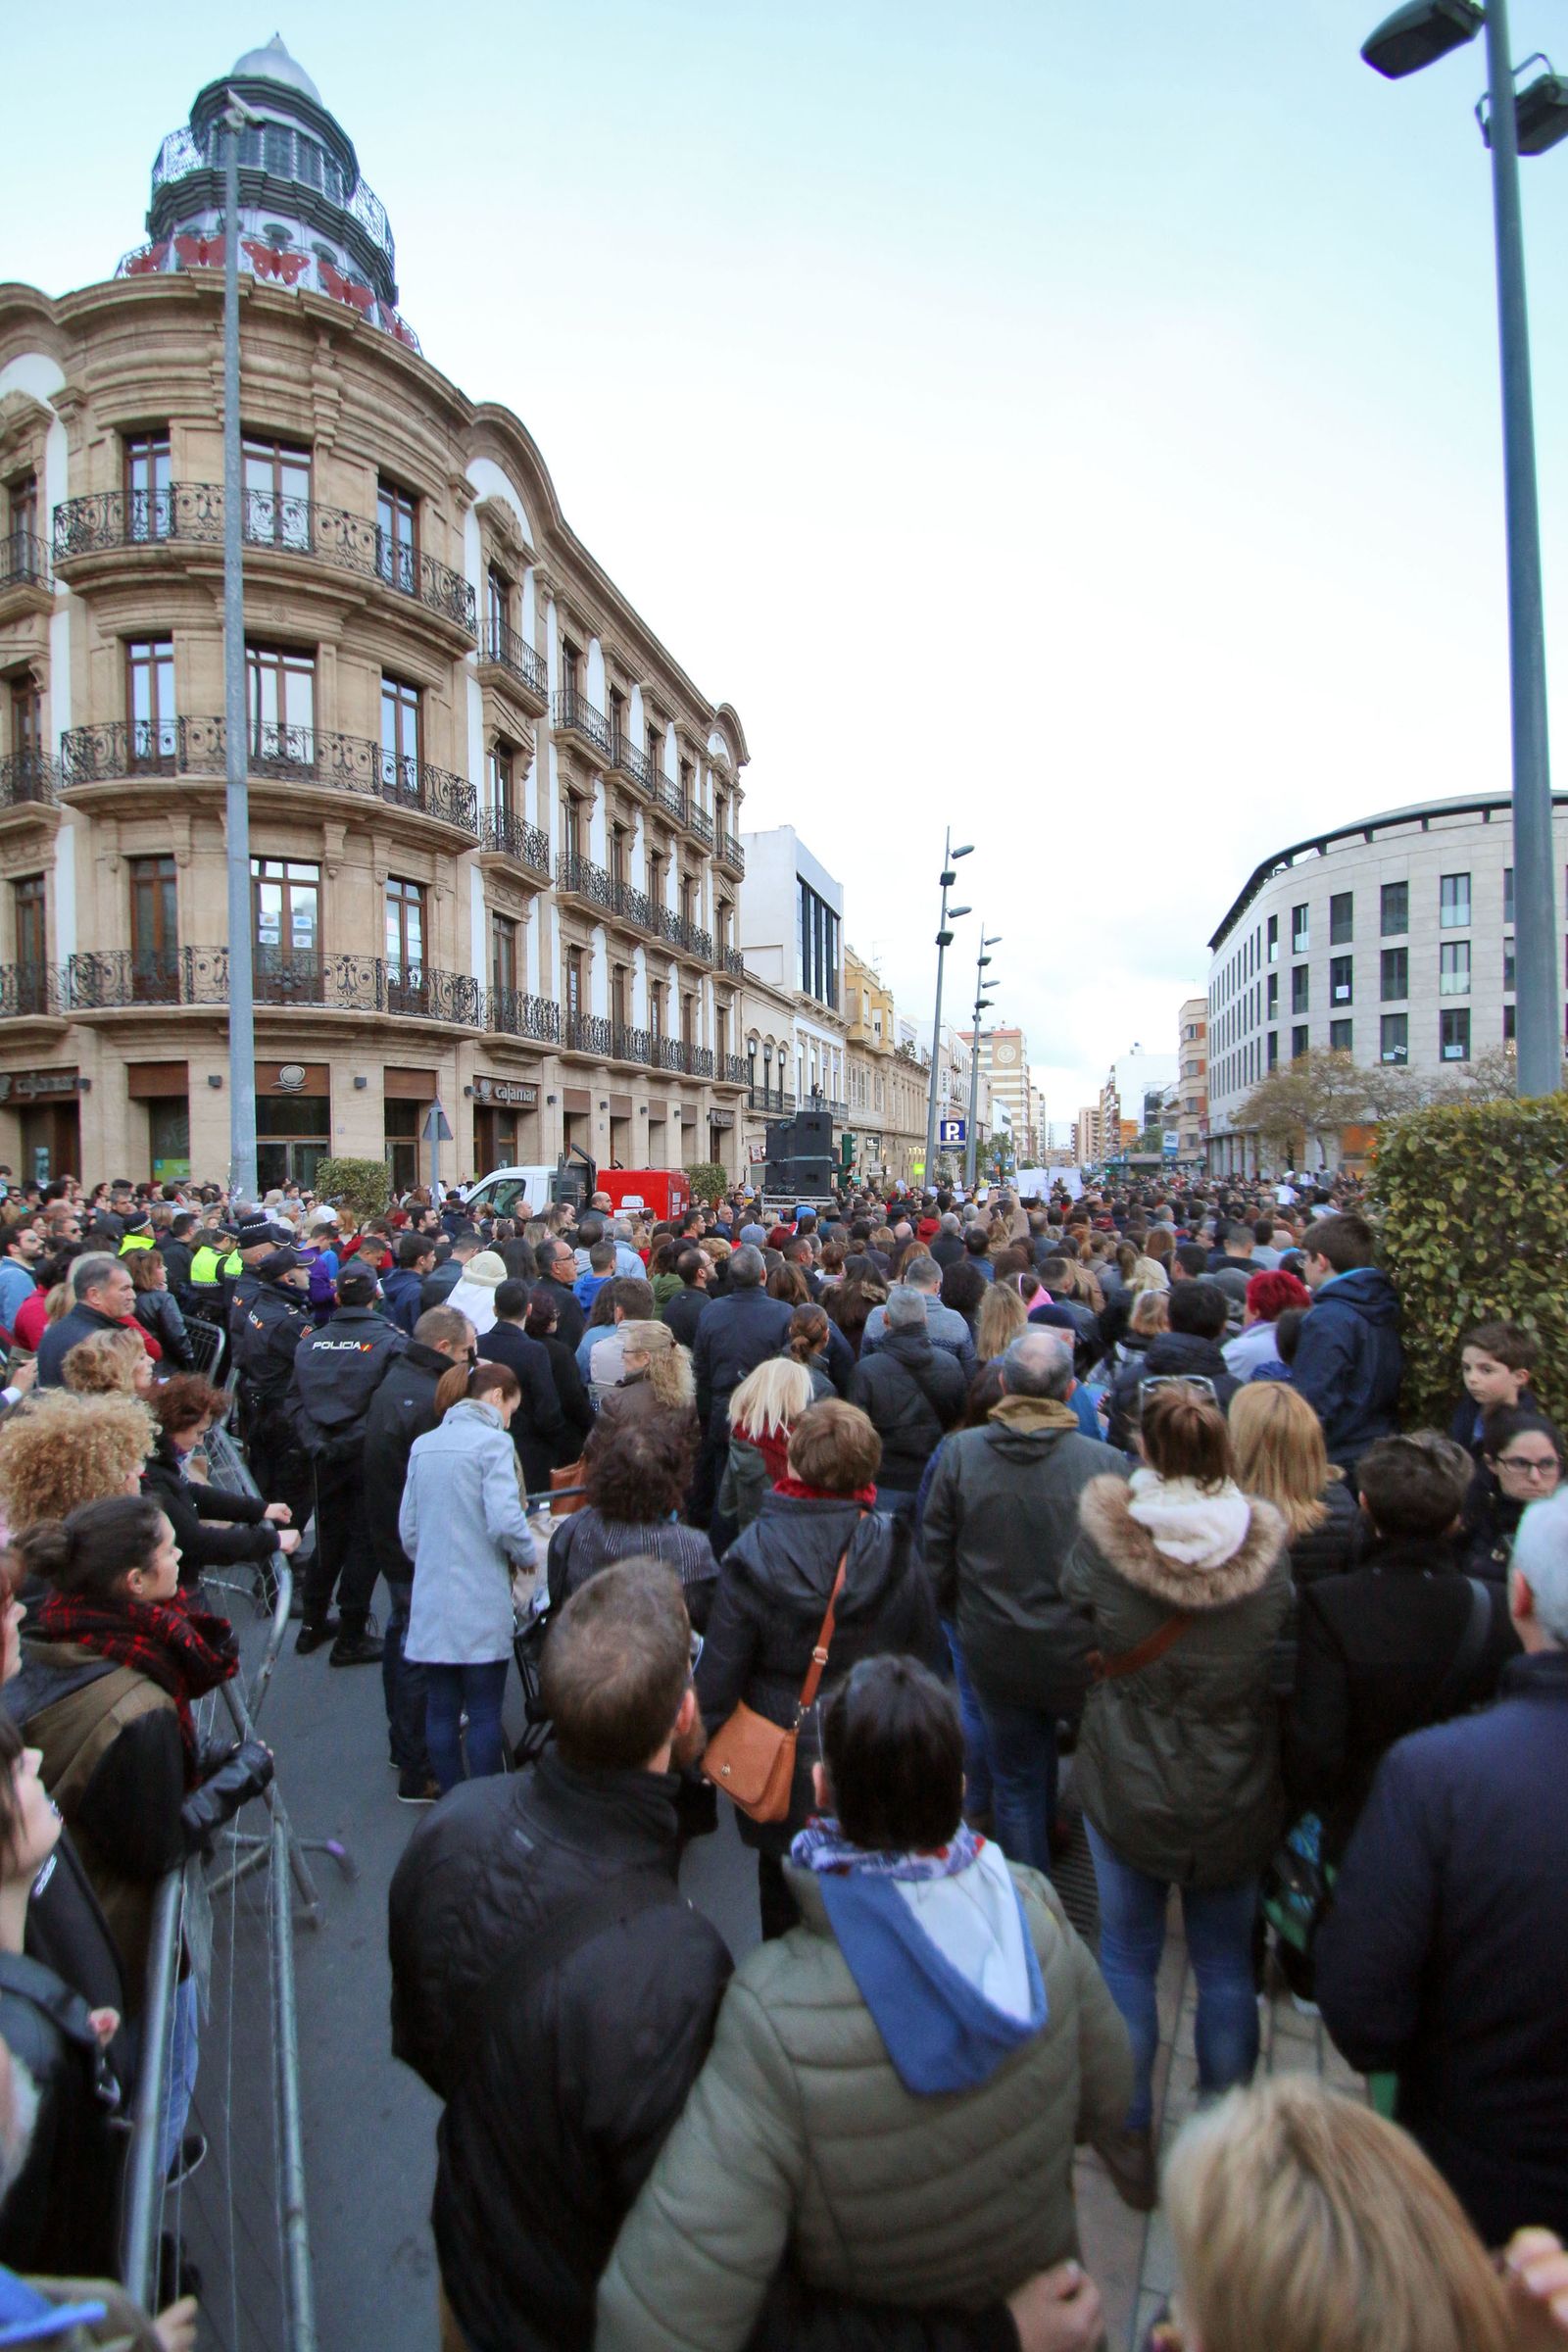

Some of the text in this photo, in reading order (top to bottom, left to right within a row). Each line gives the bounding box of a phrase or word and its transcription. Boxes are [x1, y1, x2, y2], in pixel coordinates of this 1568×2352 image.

[495, 1082, 536, 1105] cajamar
[946, 1121, 959, 1140] P
[312, 1341, 361, 1349] POLICIA
